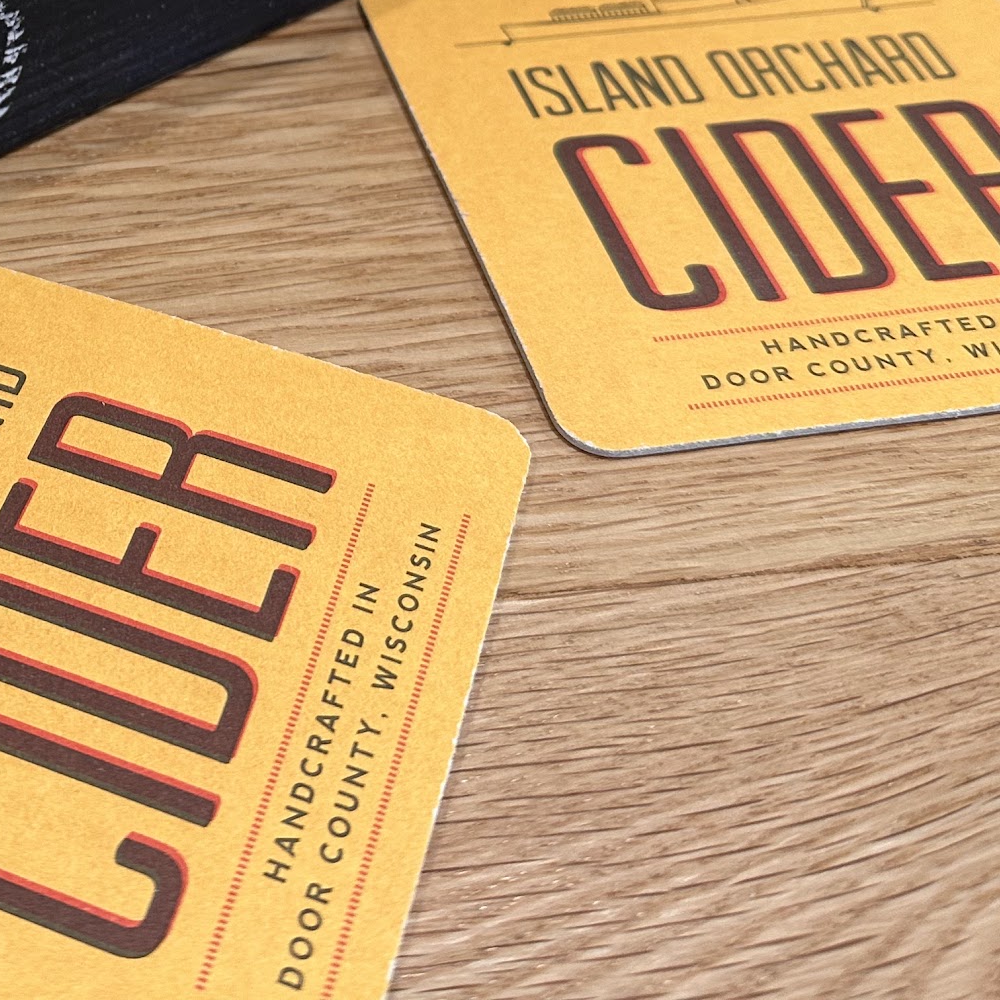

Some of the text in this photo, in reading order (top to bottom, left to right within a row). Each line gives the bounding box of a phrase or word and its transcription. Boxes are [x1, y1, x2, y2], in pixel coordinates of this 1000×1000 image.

[508, 31, 958, 119] ISLAND ORCHARD
[701, 366, 794, 390] DOOR
[807, 348, 952, 377] COUNTY,
[761, 315, 997, 354] HANDCRAFTED
[263, 581, 381, 884] HANDCRAFTED IN
[277, 522, 442, 991] DOOR COUNTY, WISCONSIN
